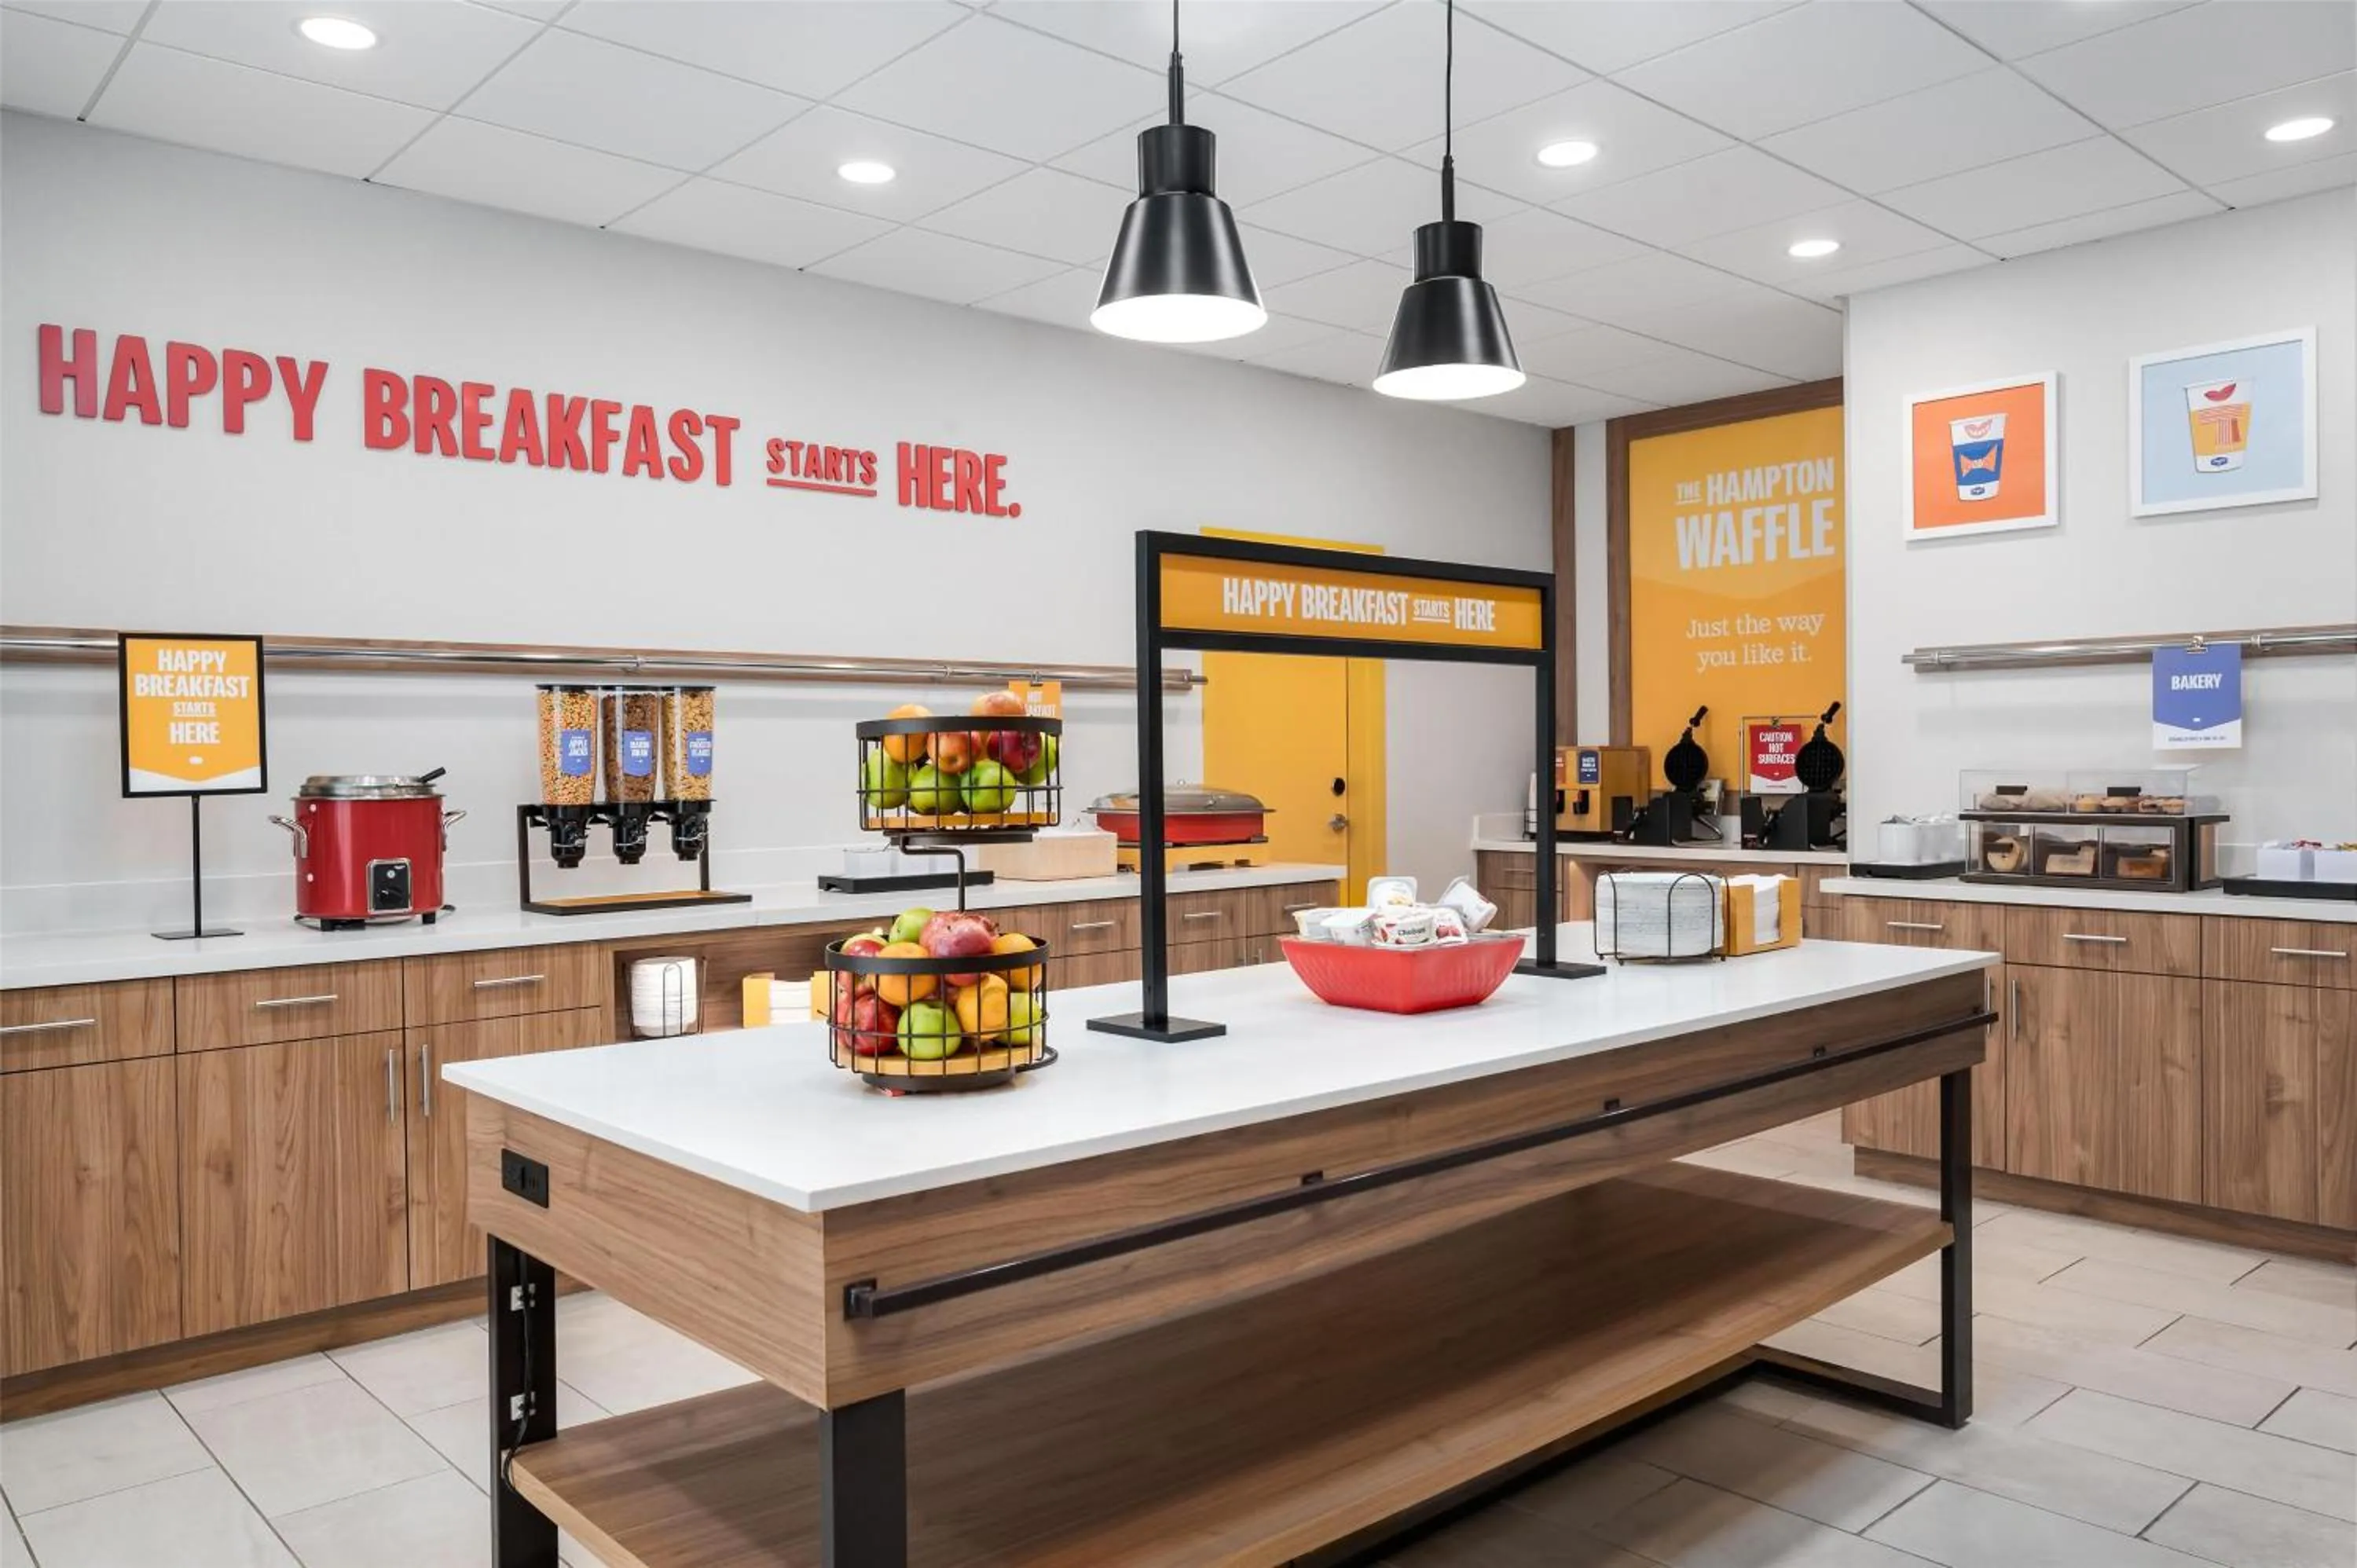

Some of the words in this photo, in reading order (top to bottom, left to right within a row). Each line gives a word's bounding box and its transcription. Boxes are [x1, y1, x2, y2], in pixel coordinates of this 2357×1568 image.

[40, 324, 328, 441] HAPPY
[363, 368, 740, 487] BREAKFAST
[766, 438, 878, 485] STARTS
[896, 441, 1021, 518] HERE.
[1676, 480, 1701, 501] THE
[1706, 456, 1835, 507] HAMPTON
[1675, 498, 1835, 571] WAFFLE
[1222, 577, 1296, 618] HAPPY
[1301, 584, 1409, 626] BREAKFAST
[1413, 599, 1450, 619] STARTS
[1453, 597, 1497, 632] HERE
[1686, 619, 1730, 639] Just
[1736, 614, 1771, 636] the
[1776, 613, 1826, 637] way
[157, 649, 227, 674] HAPPY
[1696, 649, 1736, 673] you
[1743, 643, 1784, 665] like
[1790, 640, 1812, 663] it.
[134, 673, 251, 698] BREAKFAST
[2171, 673, 2223, 691] BAKERY
[172, 701, 217, 716] STARTS
[168, 721, 221, 745] HERE
[1759, 731, 1794, 742] CAUTION
[1758, 753, 1796, 764] SURFACES
[1769, 742, 1784, 753] HOT
